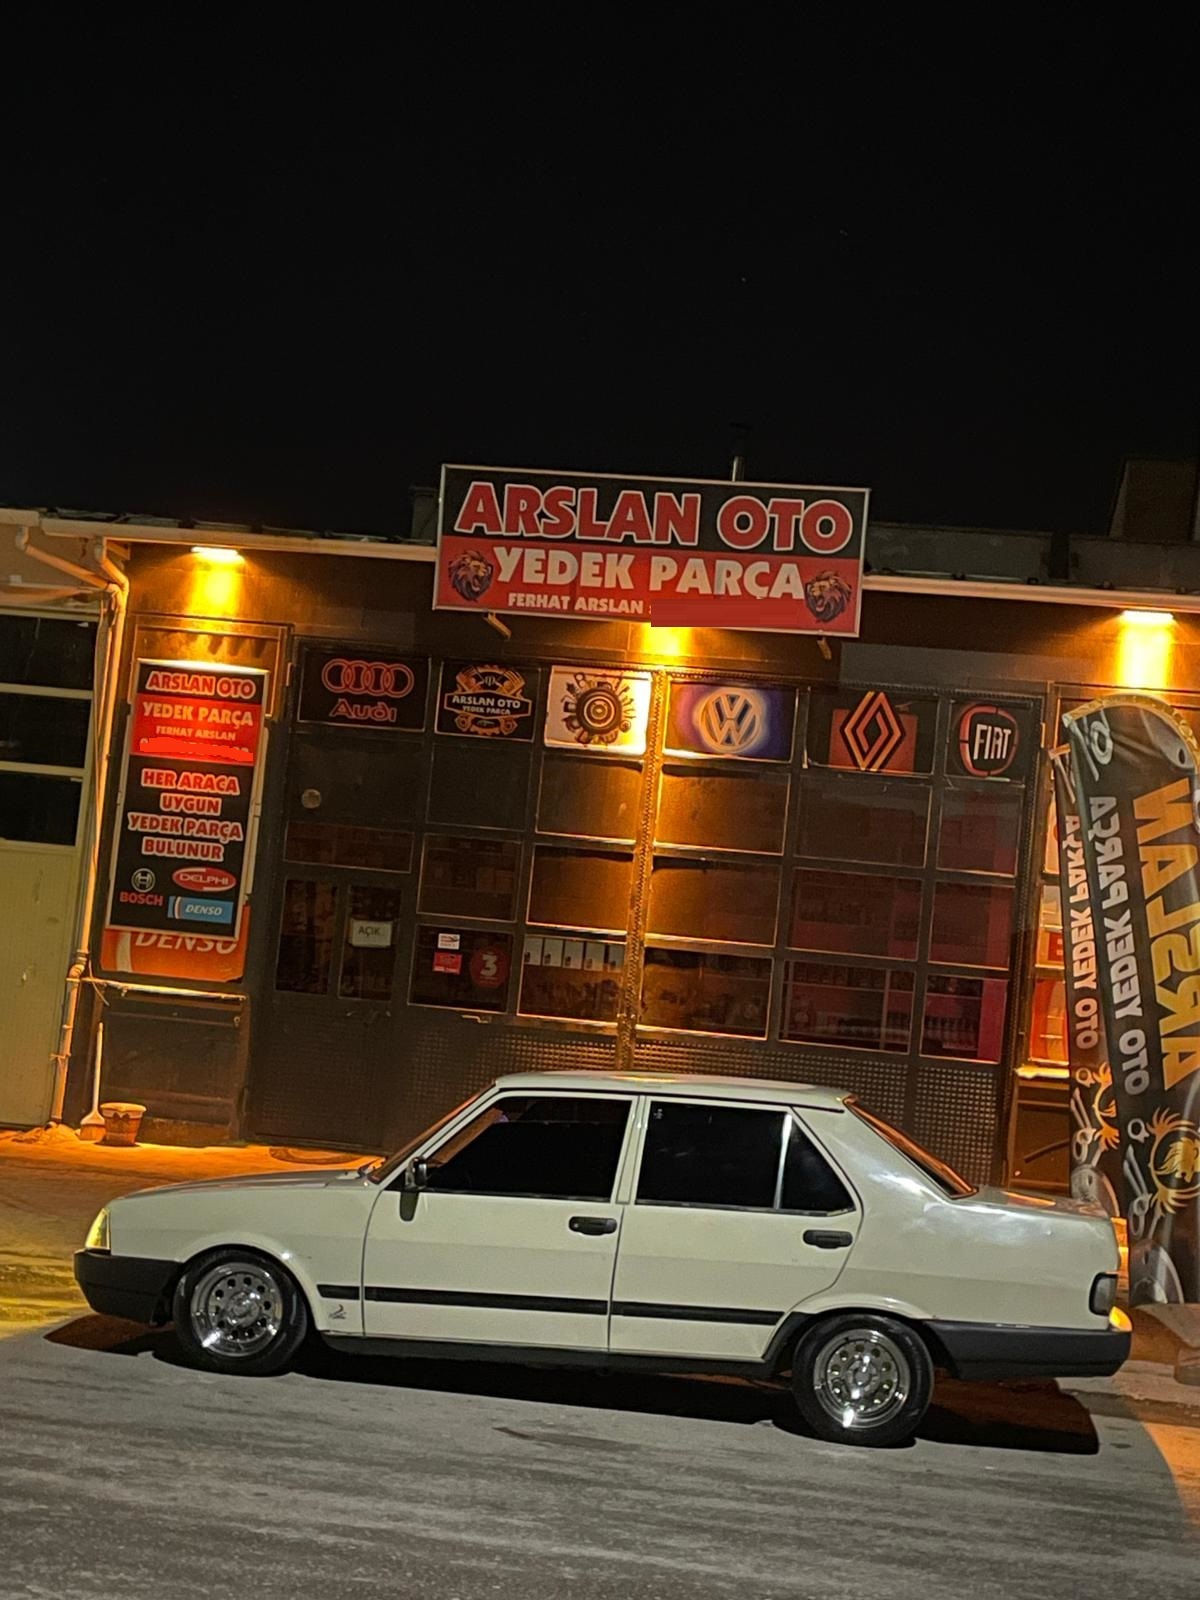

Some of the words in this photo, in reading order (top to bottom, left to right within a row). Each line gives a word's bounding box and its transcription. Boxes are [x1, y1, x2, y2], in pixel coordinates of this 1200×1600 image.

[454, 481, 703, 546] ARSLAN
[716, 495, 853, 554] OTO
[493, 546, 635, 590] YEDEK
[649, 556, 806, 600] PARÇA
[508, 592, 570, 610] FERHAT
[574, 597, 644, 614] ARSLAN
[145, 671, 216, 696] ARSLAN
[216, 677, 256, 699] OTO
[329, 698, 397, 722] Audi
[452, 695, 495, 707] ARSLAN
[497, 699, 521, 709] OTO
[143, 701, 194, 721] YEDEK
[198, 707, 253, 730] PARÇA
[156, 725, 193, 737] FERHAT
[195, 728, 236, 741] ARSLAN
[973, 723, 1012, 760] FIAT
[141, 768, 177, 788] HER
[178, 772, 240, 795] ARACA
[160, 793, 222, 815] UYGUN
[127, 812, 183, 835] YEDEK
[183, 818, 243, 844] PARÇA
[141, 836, 224, 862] BULUNUR
[179, 872, 229, 885] DELPHI
[119, 891, 164, 906] BOSCH
[185, 903, 223, 916] DENSO
